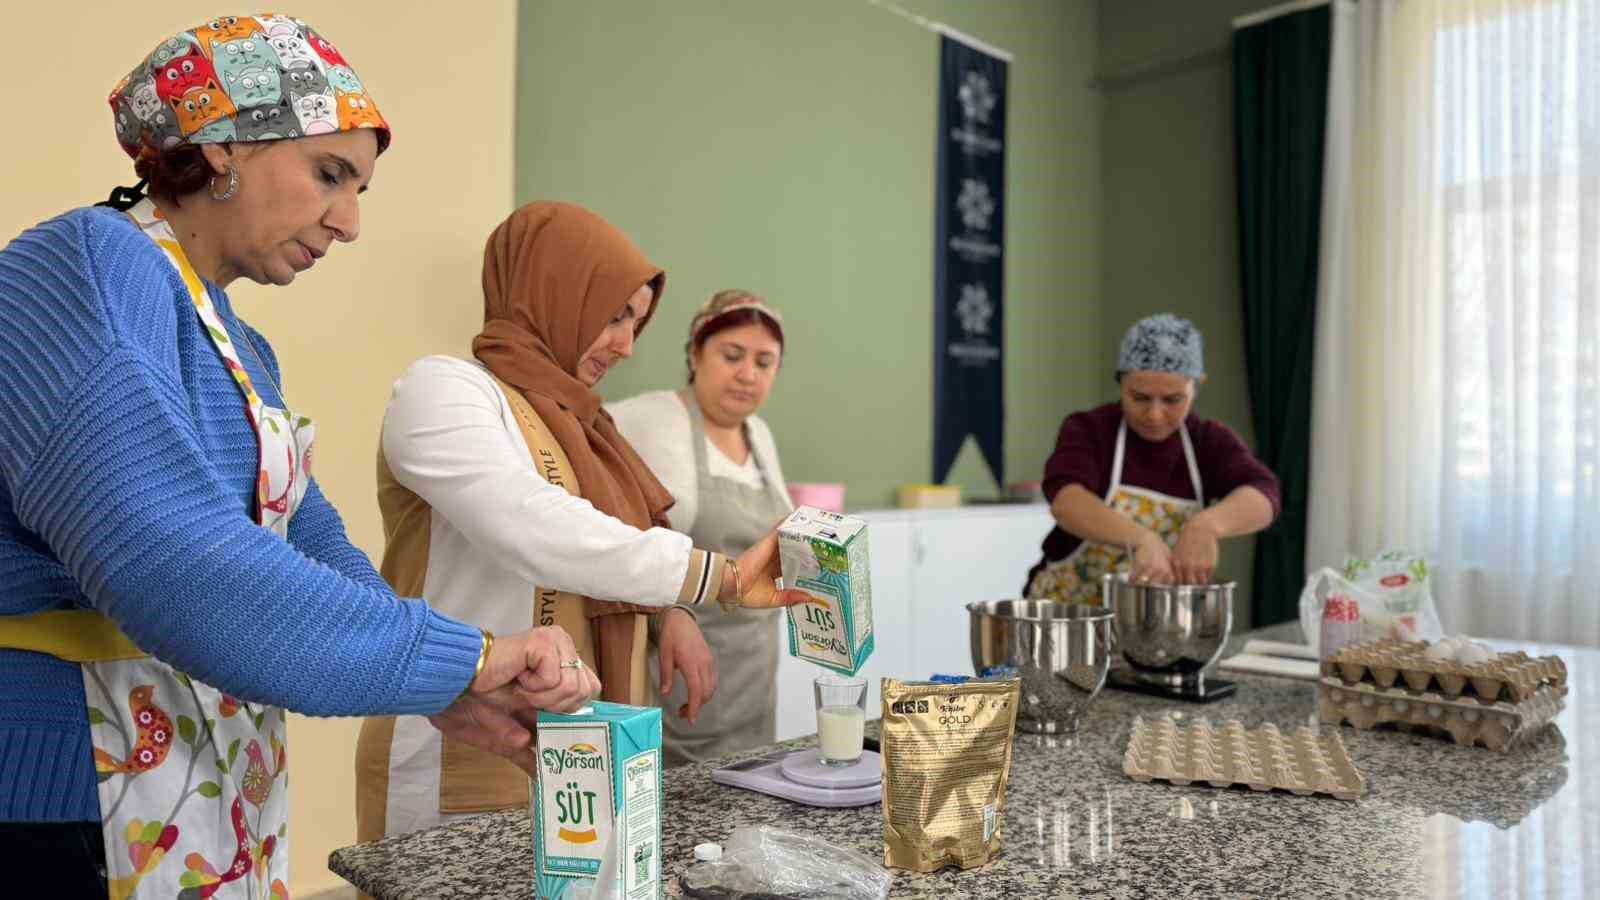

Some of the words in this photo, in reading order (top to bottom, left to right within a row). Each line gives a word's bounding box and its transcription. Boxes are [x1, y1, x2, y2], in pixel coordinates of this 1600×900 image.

[540, 590, 557, 627] STYL
[805, 605, 836, 632] SÜT
[938, 715, 972, 725] GOLD
[558, 748, 605, 774] Yörsan
[556, 782, 597, 825] SÜT
